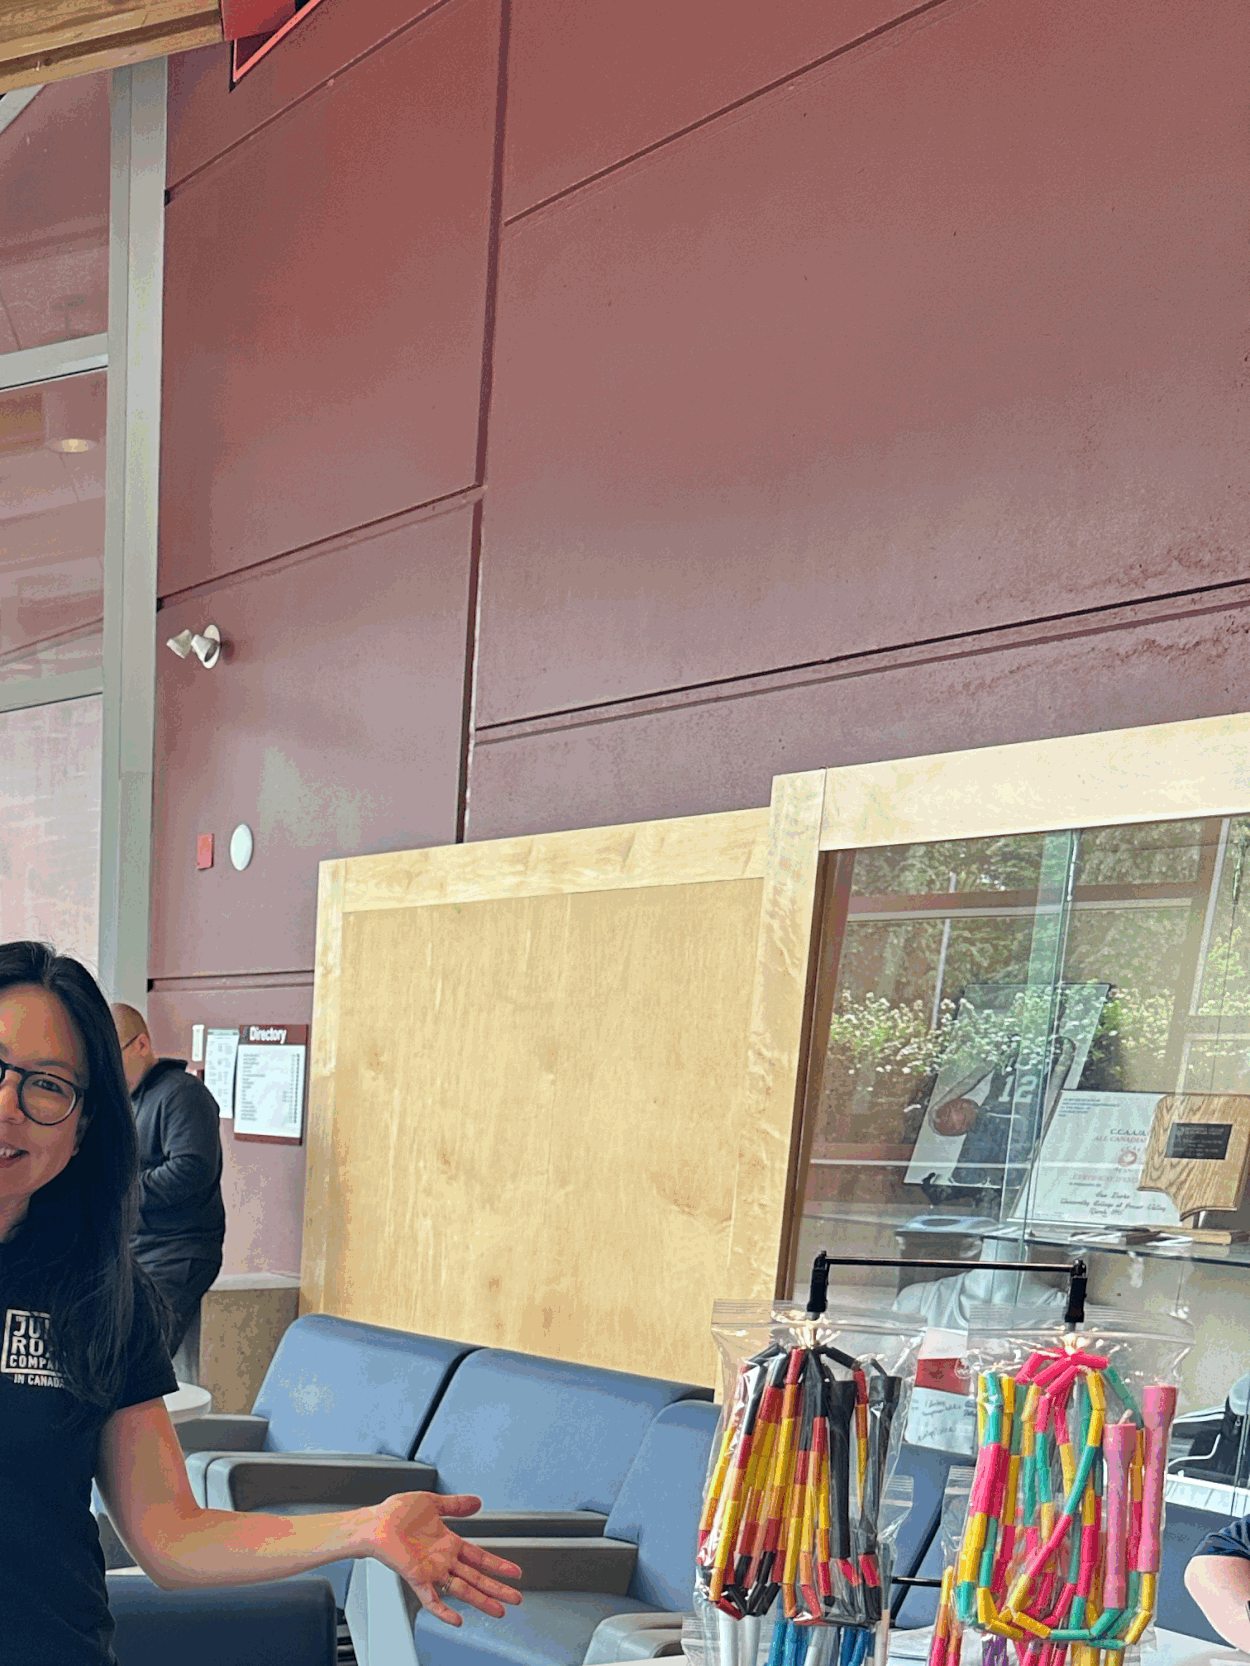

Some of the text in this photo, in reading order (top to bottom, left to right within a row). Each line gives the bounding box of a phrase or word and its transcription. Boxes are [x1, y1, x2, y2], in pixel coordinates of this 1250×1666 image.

[249, 1026, 287, 1044] Directory
[998, 1075, 1038, 1103] 12
[13, 1315, 50, 1340] JU
[13, 1374, 24, 1384] IN
